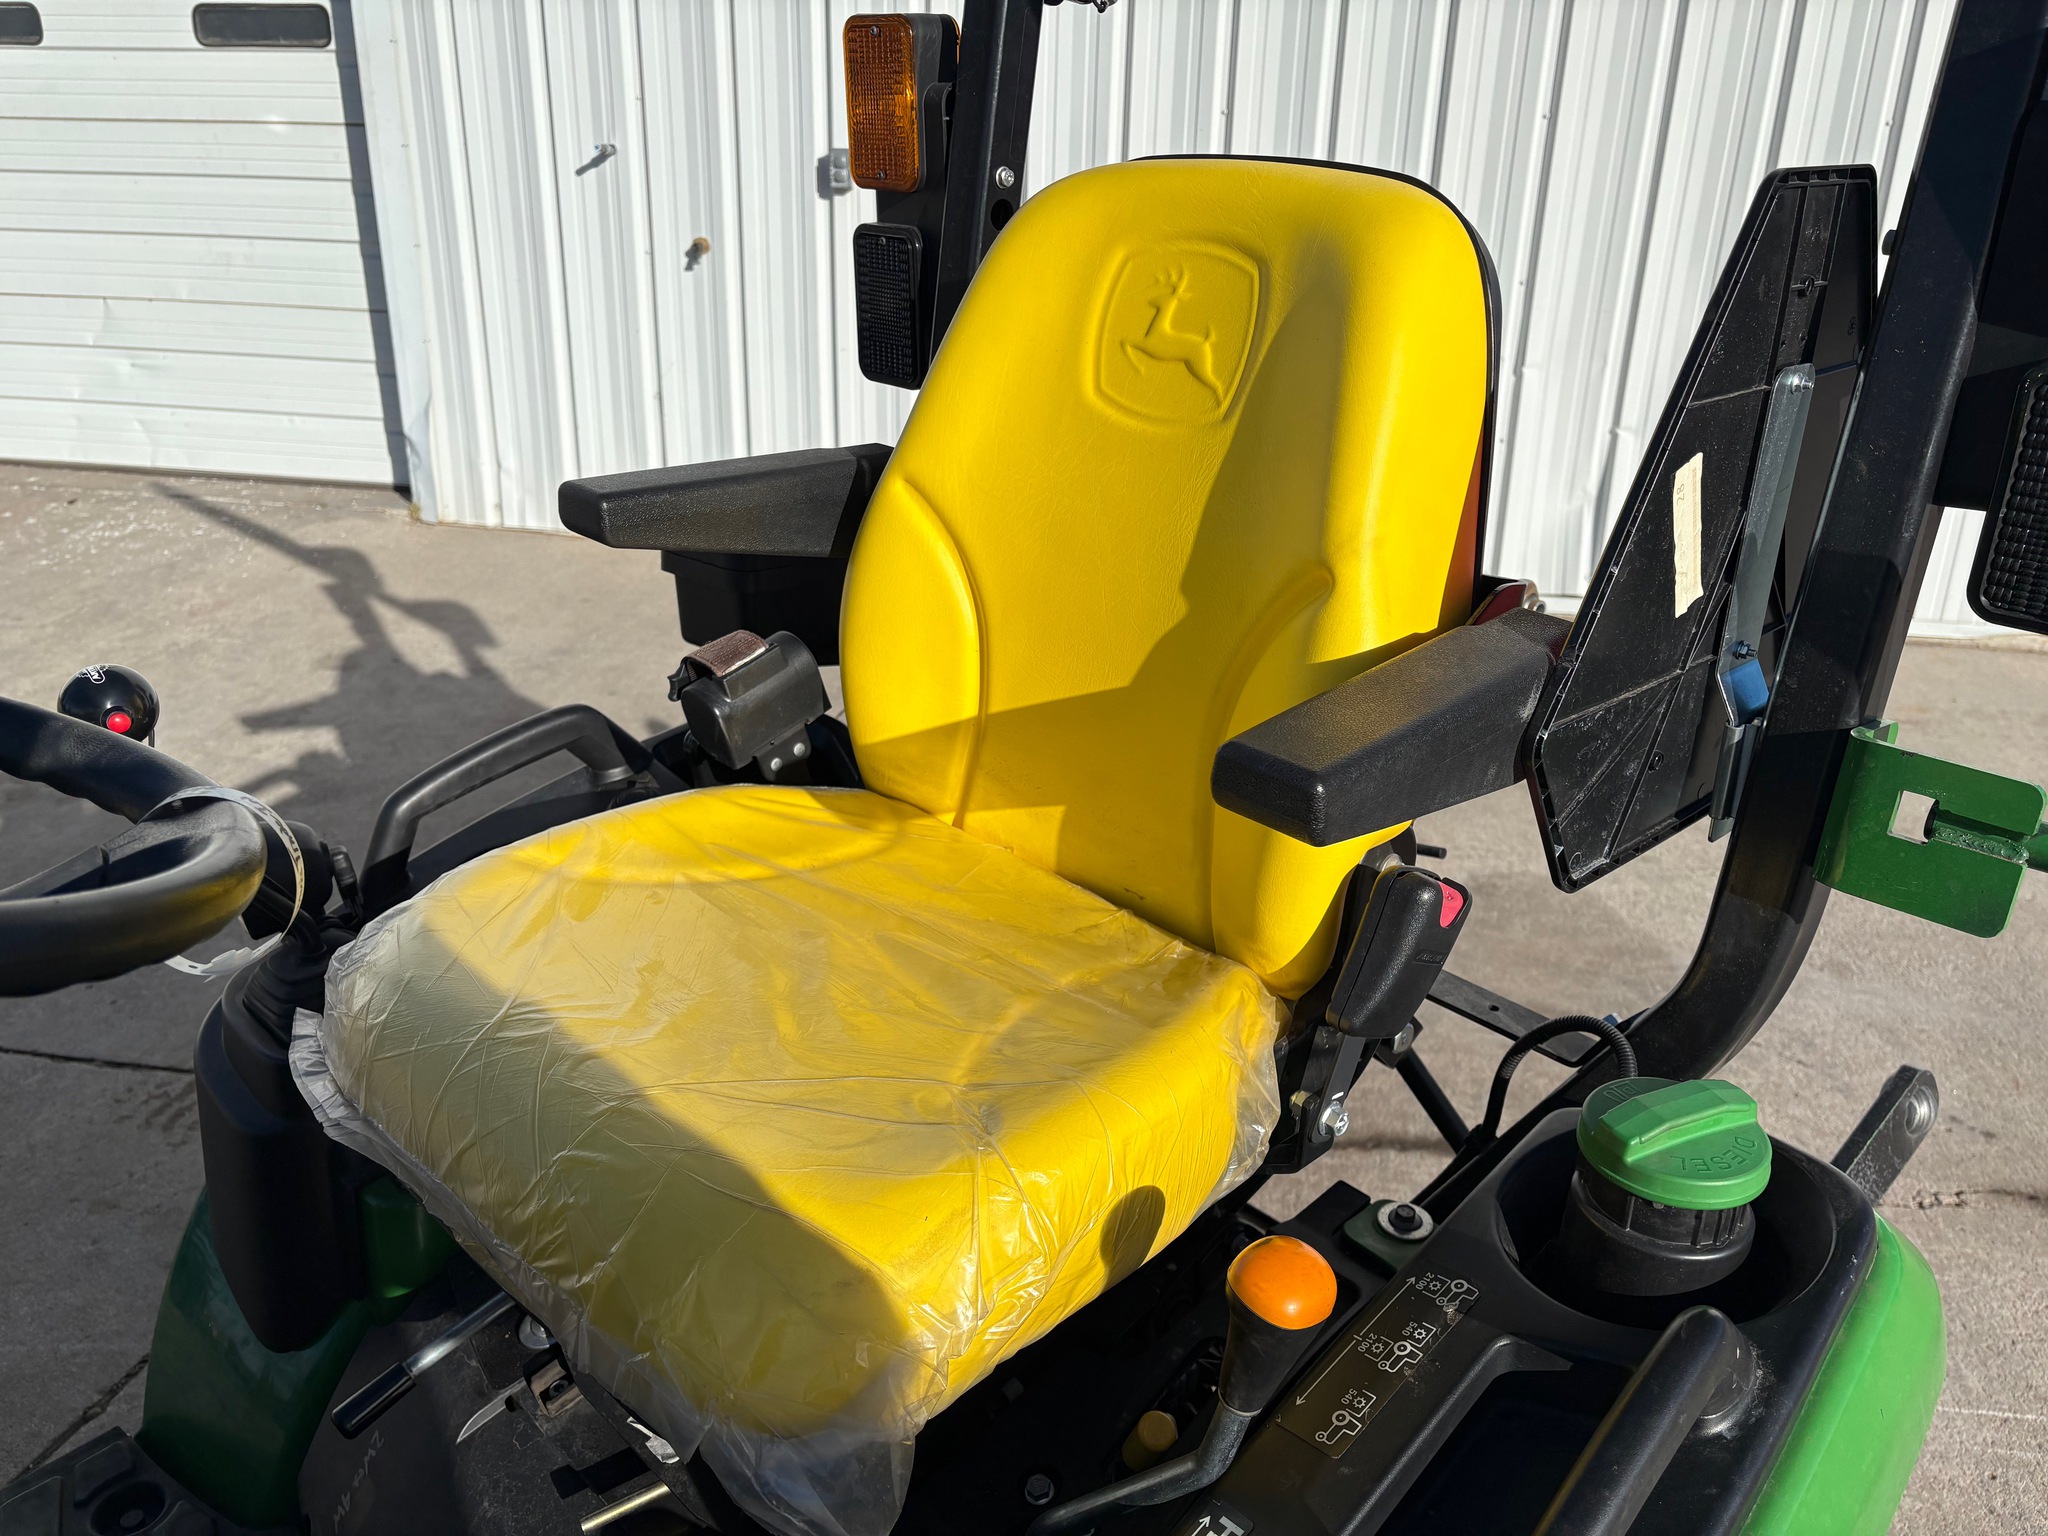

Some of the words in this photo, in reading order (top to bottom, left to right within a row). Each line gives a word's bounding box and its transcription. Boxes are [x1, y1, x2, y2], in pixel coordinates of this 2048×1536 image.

[1670, 1136, 1758, 1173] DIESEL
[1415, 1271, 1435, 1291] 2100
[1401, 1321, 1418, 1337] 540
[1357, 1332, 1378, 1353] 2100
[1341, 1388, 1358, 1405] 540
